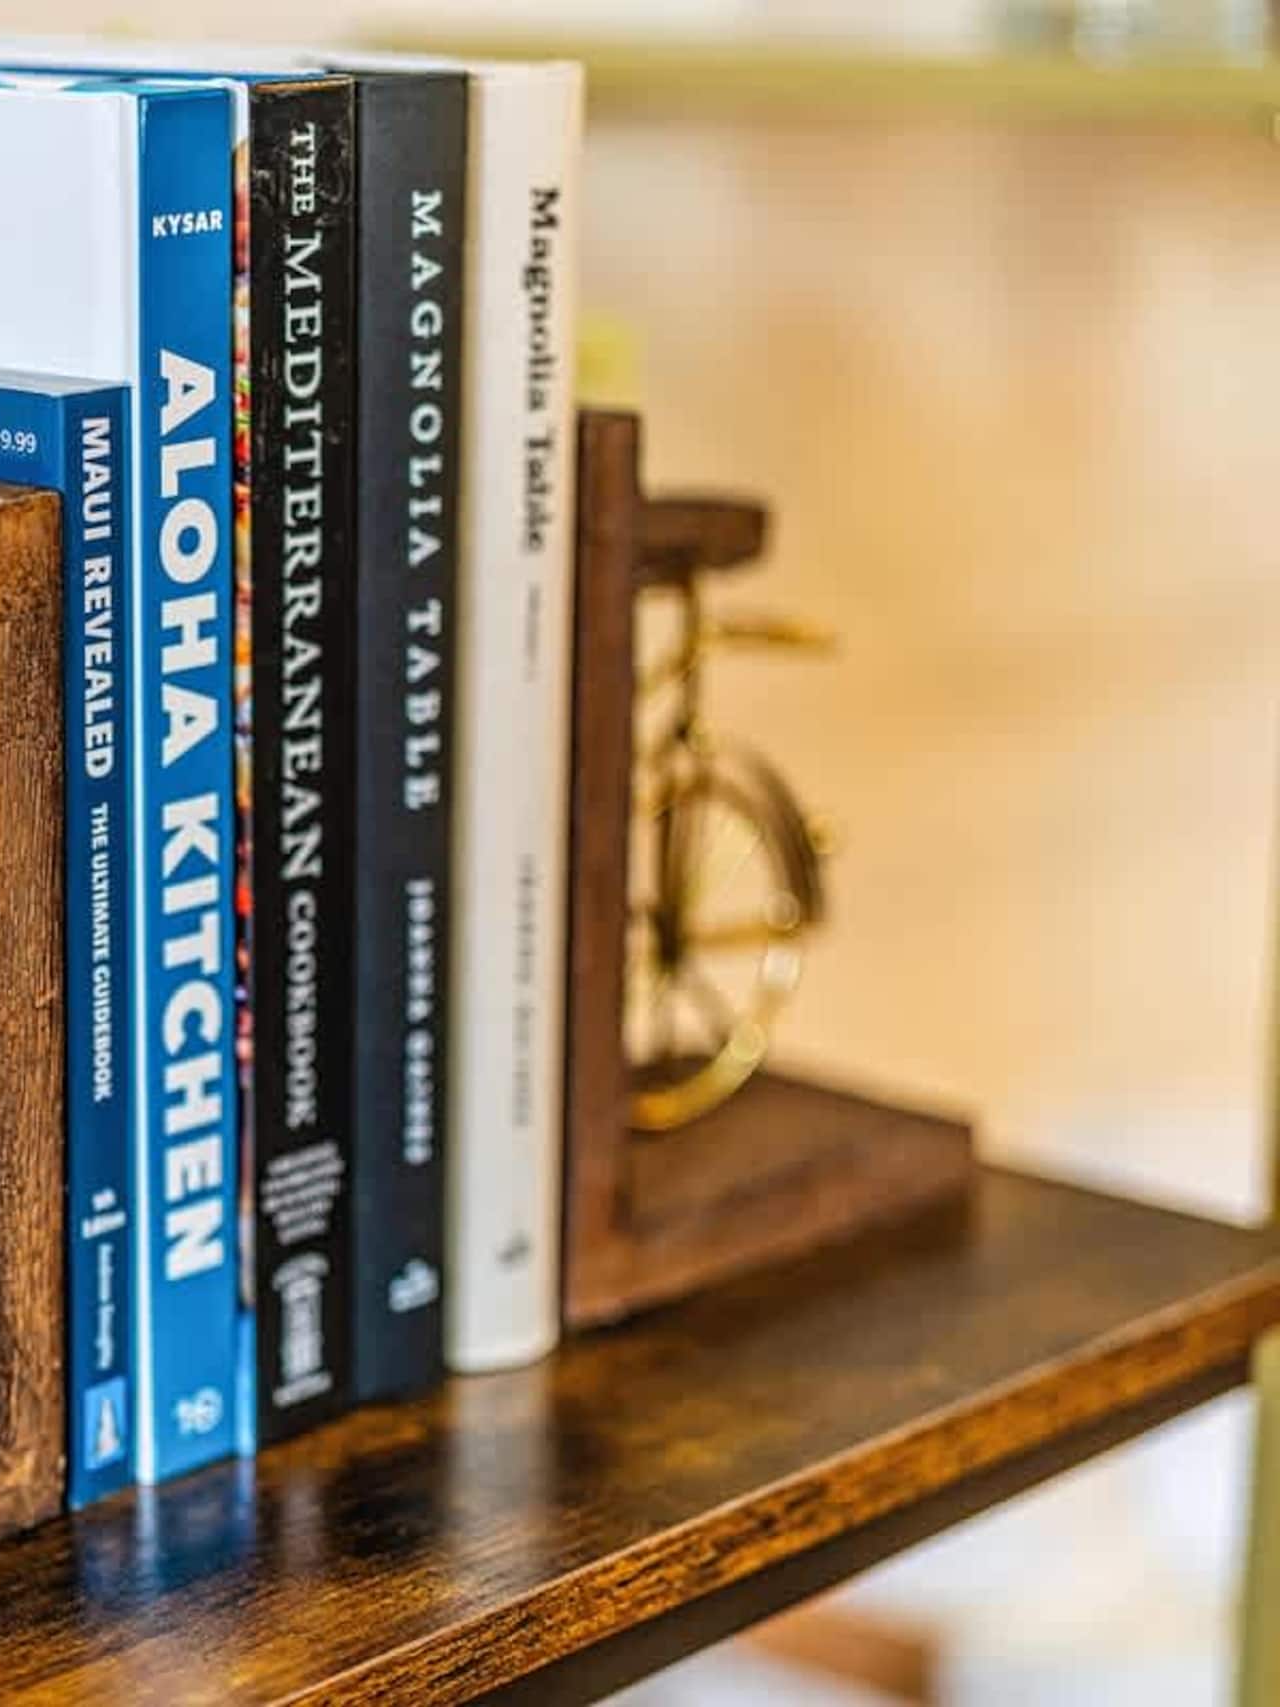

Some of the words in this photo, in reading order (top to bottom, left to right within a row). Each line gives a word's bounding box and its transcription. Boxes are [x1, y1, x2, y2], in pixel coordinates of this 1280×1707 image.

[152, 209, 223, 237] KYSAR
[290, 122, 317, 217] THE
[407, 189, 444, 567] MAGNOLIA
[522, 187, 560, 413] Magnolia
[81, 416, 113, 542] MAUI
[159, 348, 218, 768] ALOHA
[280, 230, 322, 880] MEDITERRANEAN
[522, 428, 558, 555] Table
[83, 554, 115, 779] REVEALED
[403, 598, 442, 811] TABLE
[90, 801, 110, 849] THE
[91, 851, 111, 963] ULTIMATE
[93, 963, 113, 1103] GUIDEBOOK
[162, 791, 224, 1281] KITCHEN
[286, 891, 317, 1130] COOKBOOK
